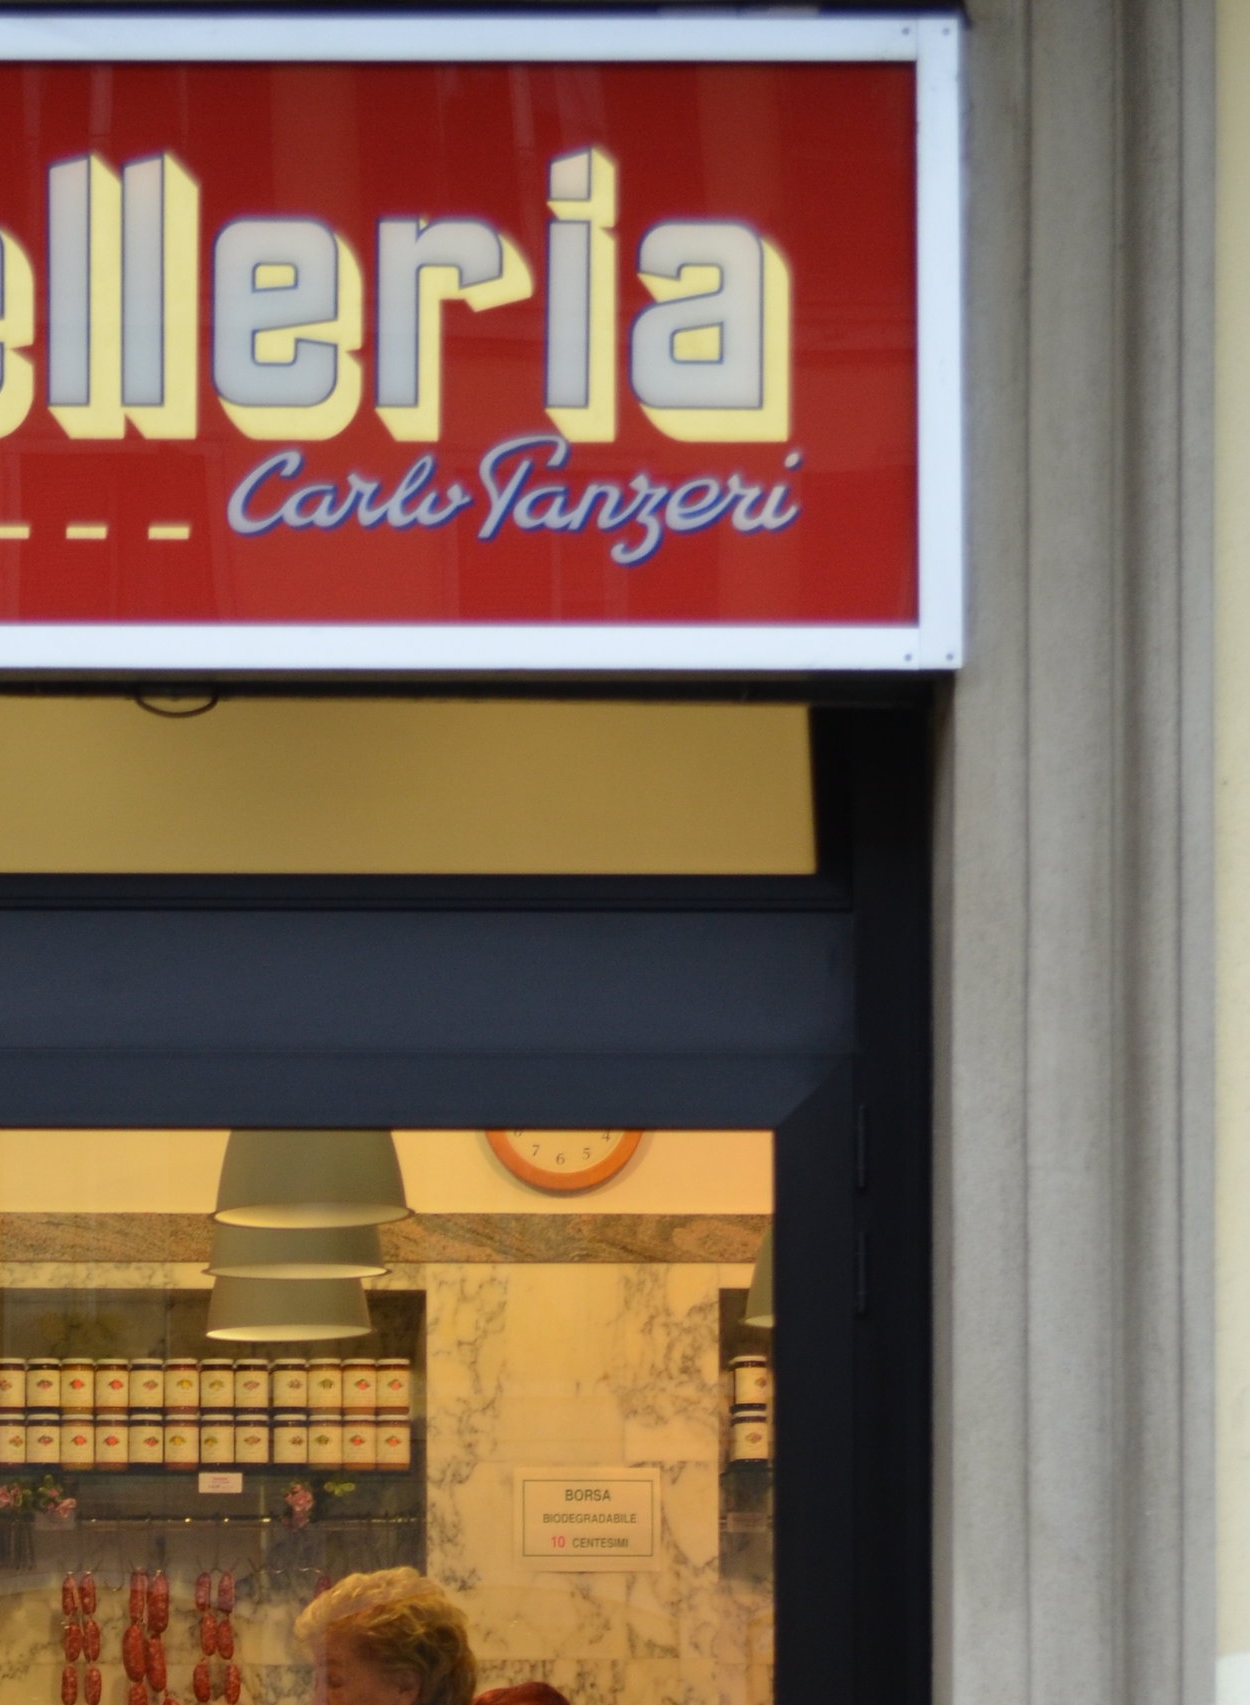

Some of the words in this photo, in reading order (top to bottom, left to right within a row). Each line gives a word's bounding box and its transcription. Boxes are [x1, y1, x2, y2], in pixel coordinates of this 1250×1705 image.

[227, 449, 473, 535] Carlo
[532, 1144, 540, 1157] 7
[582, 1147, 591, 1160] 5
[556, 1153, 566, 1165] 6
[564, 1488, 612, 1501] BORSA
[542, 1513, 637, 1524] BIODEGRADABILE
[551, 1535, 566, 1548] 10
[571, 1537, 629, 1549] CENTESIMI
